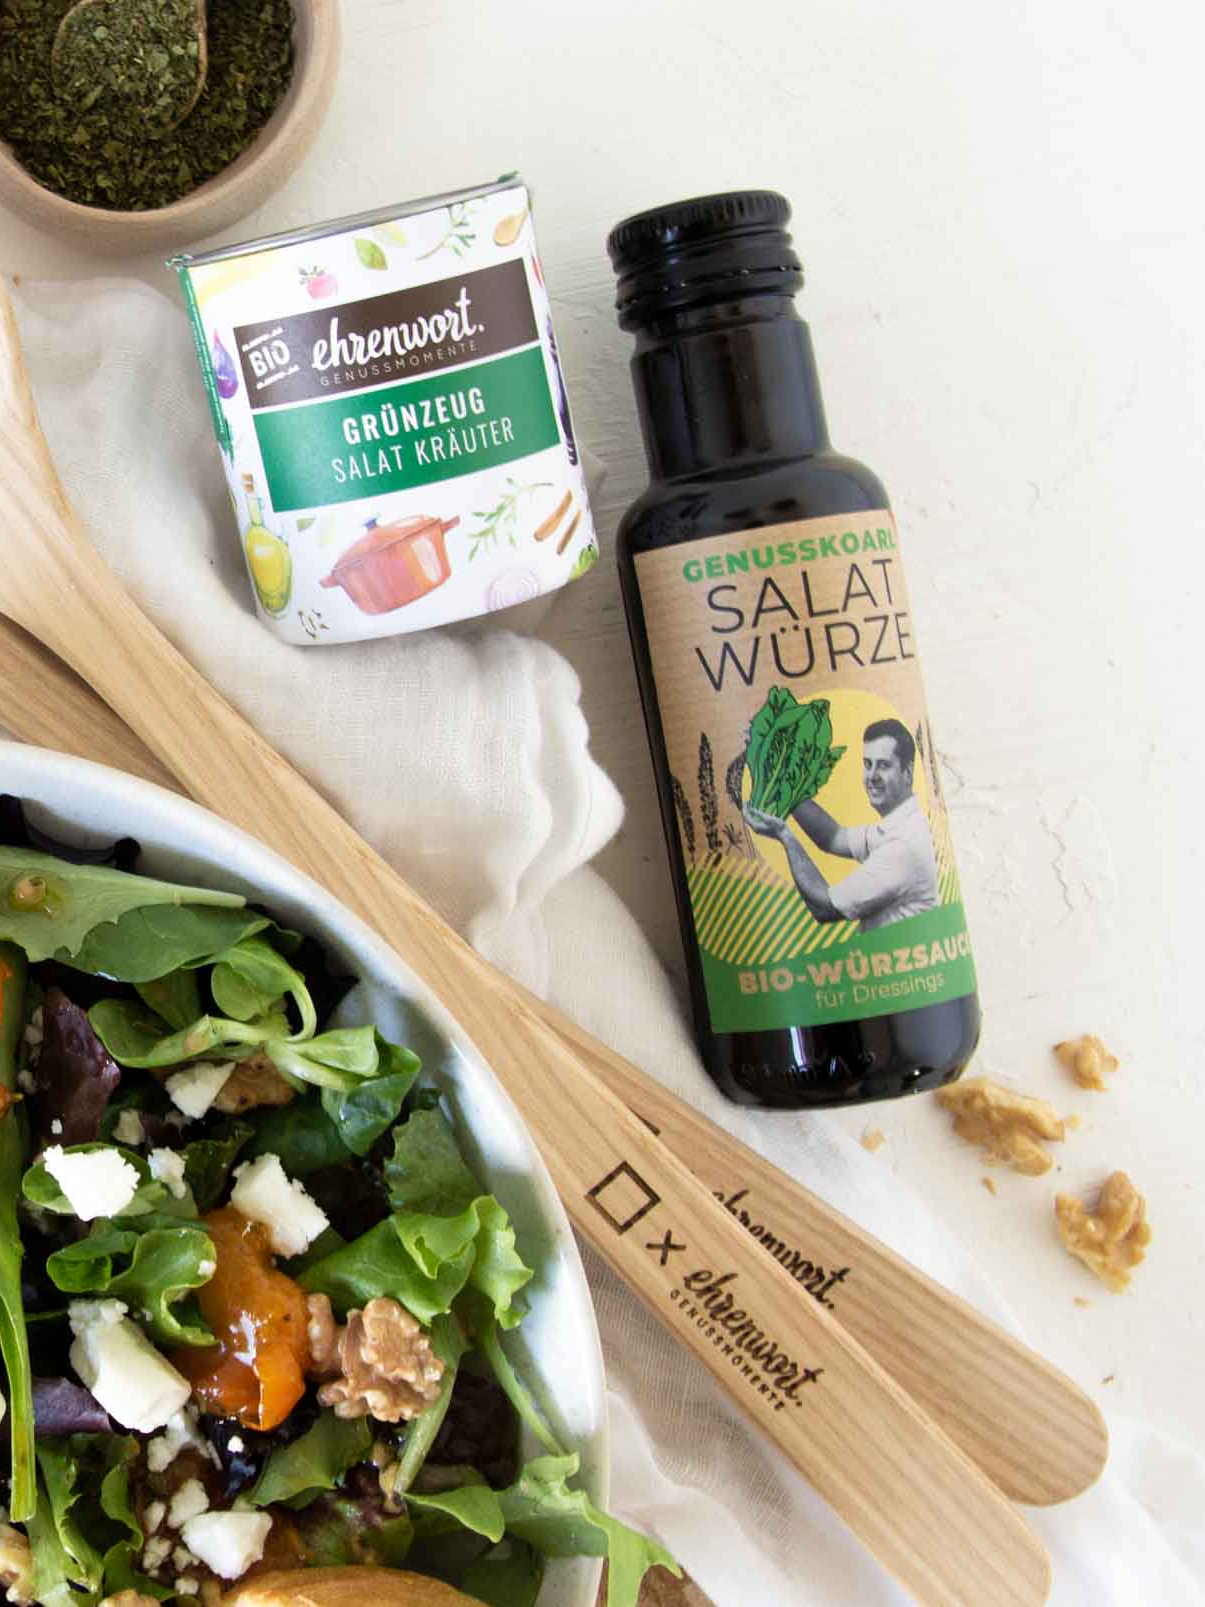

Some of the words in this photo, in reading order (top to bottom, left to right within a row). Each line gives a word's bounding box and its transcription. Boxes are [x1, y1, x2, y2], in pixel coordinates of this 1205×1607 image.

[248, 339, 291, 377] BIO
[311, 287, 485, 370] ehrenwort.
[320, 340, 477, 386] GENUSSMOMENTE
[342, 387, 486, 445] GRÜNZEUG
[331, 445, 403, 483] SALAT
[414, 416, 515, 466] KRÄUTER
[682, 527, 896, 583] GENUSSKOARL
[707, 558, 892, 634] SALAT
[695, 612, 914, 692] WÜRZE
[737, 932, 971, 995] BIO-WÜRZSAUC
[815, 988, 846, 1008] für
[853, 971, 946, 1004] Dressings
[670, 1289, 786, 1411] GENUSSMOMENTE
[683, 1269, 825, 1408] ehrenwort.
